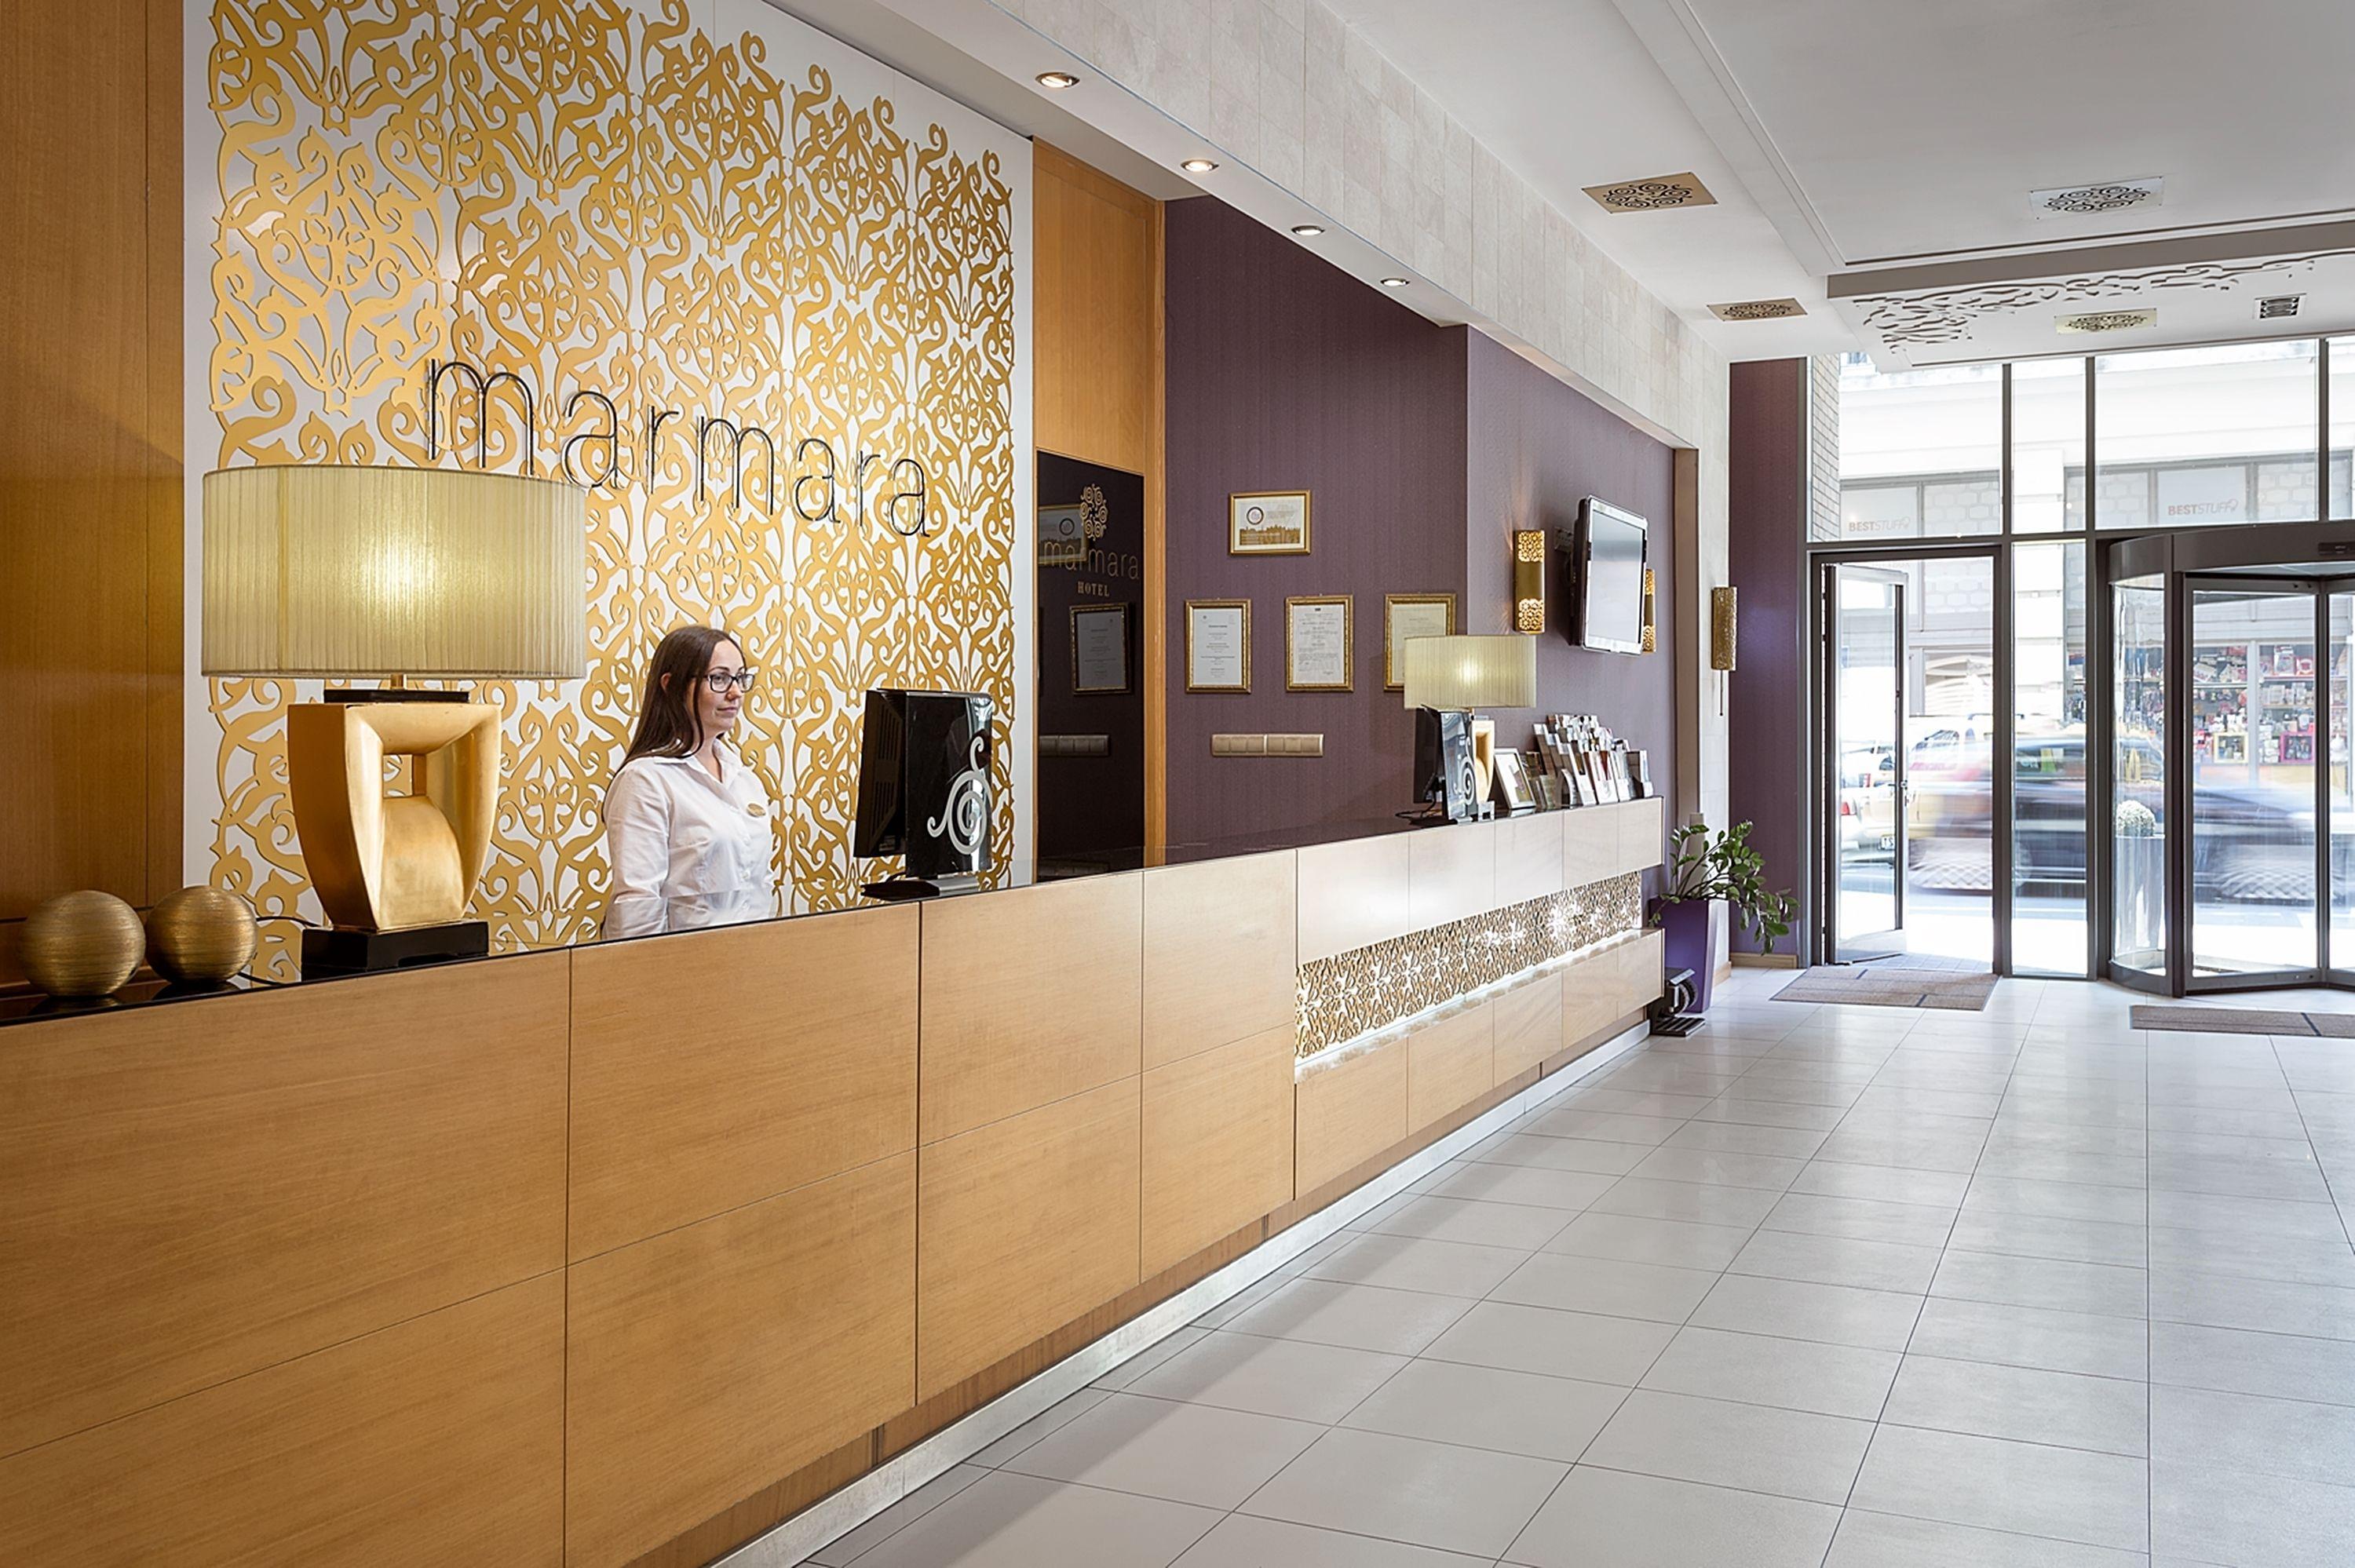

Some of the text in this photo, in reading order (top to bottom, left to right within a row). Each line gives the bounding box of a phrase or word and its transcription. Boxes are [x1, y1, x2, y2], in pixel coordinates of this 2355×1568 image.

[428, 359, 929, 538] marmara
[2168, 498, 2238, 516] BESTSTUFF
[1044, 542, 1140, 580] marmara
[1077, 581, 1110, 596] HOTEL
